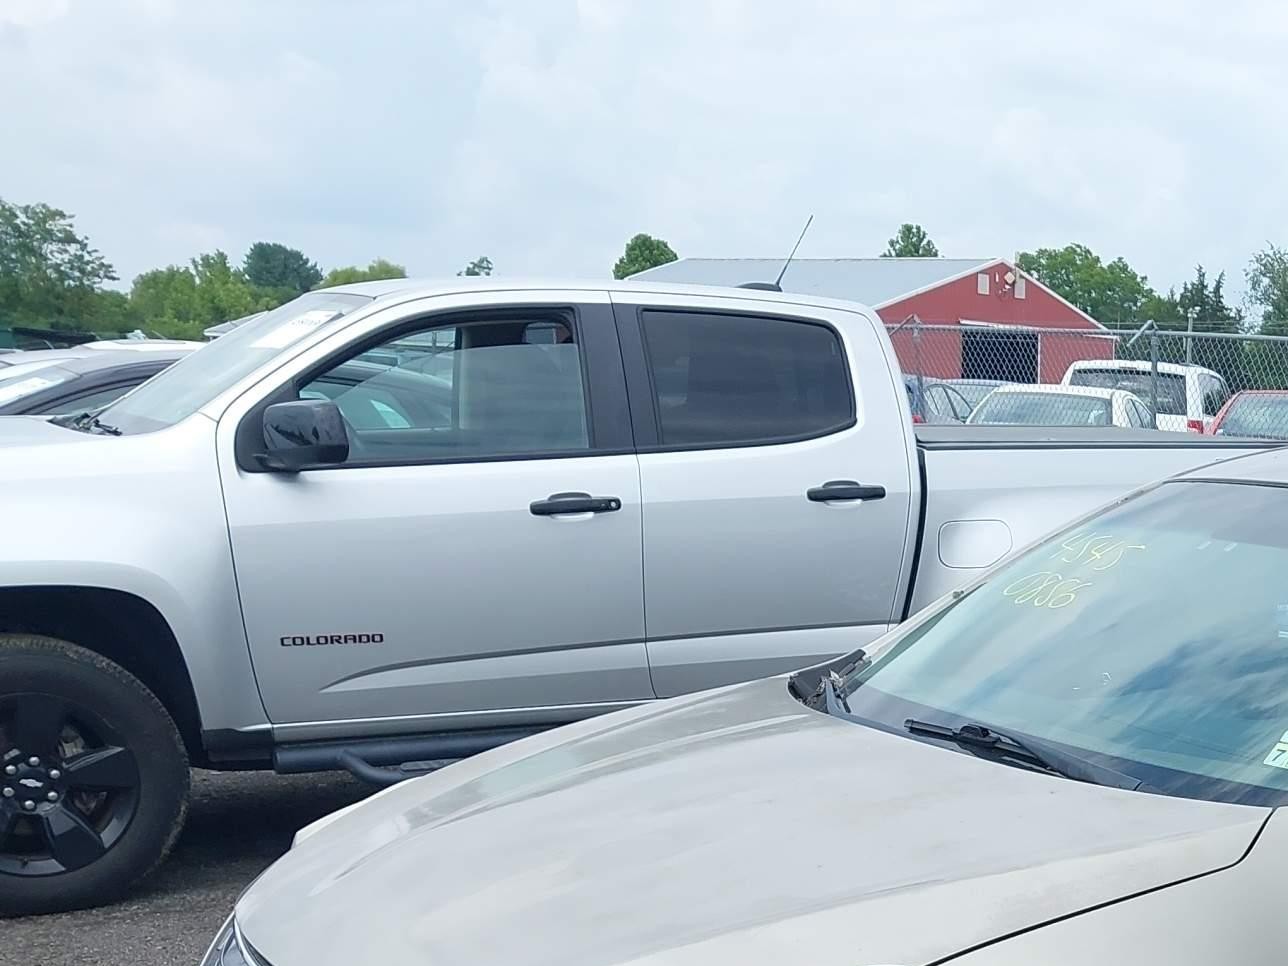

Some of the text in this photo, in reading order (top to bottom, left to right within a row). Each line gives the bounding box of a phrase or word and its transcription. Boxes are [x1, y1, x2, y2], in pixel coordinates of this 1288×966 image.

[1048, 531, 1146, 571] 4545
[279, 633, 384, 647] COLORADO
[1271, 749, 1287, 762] 7
